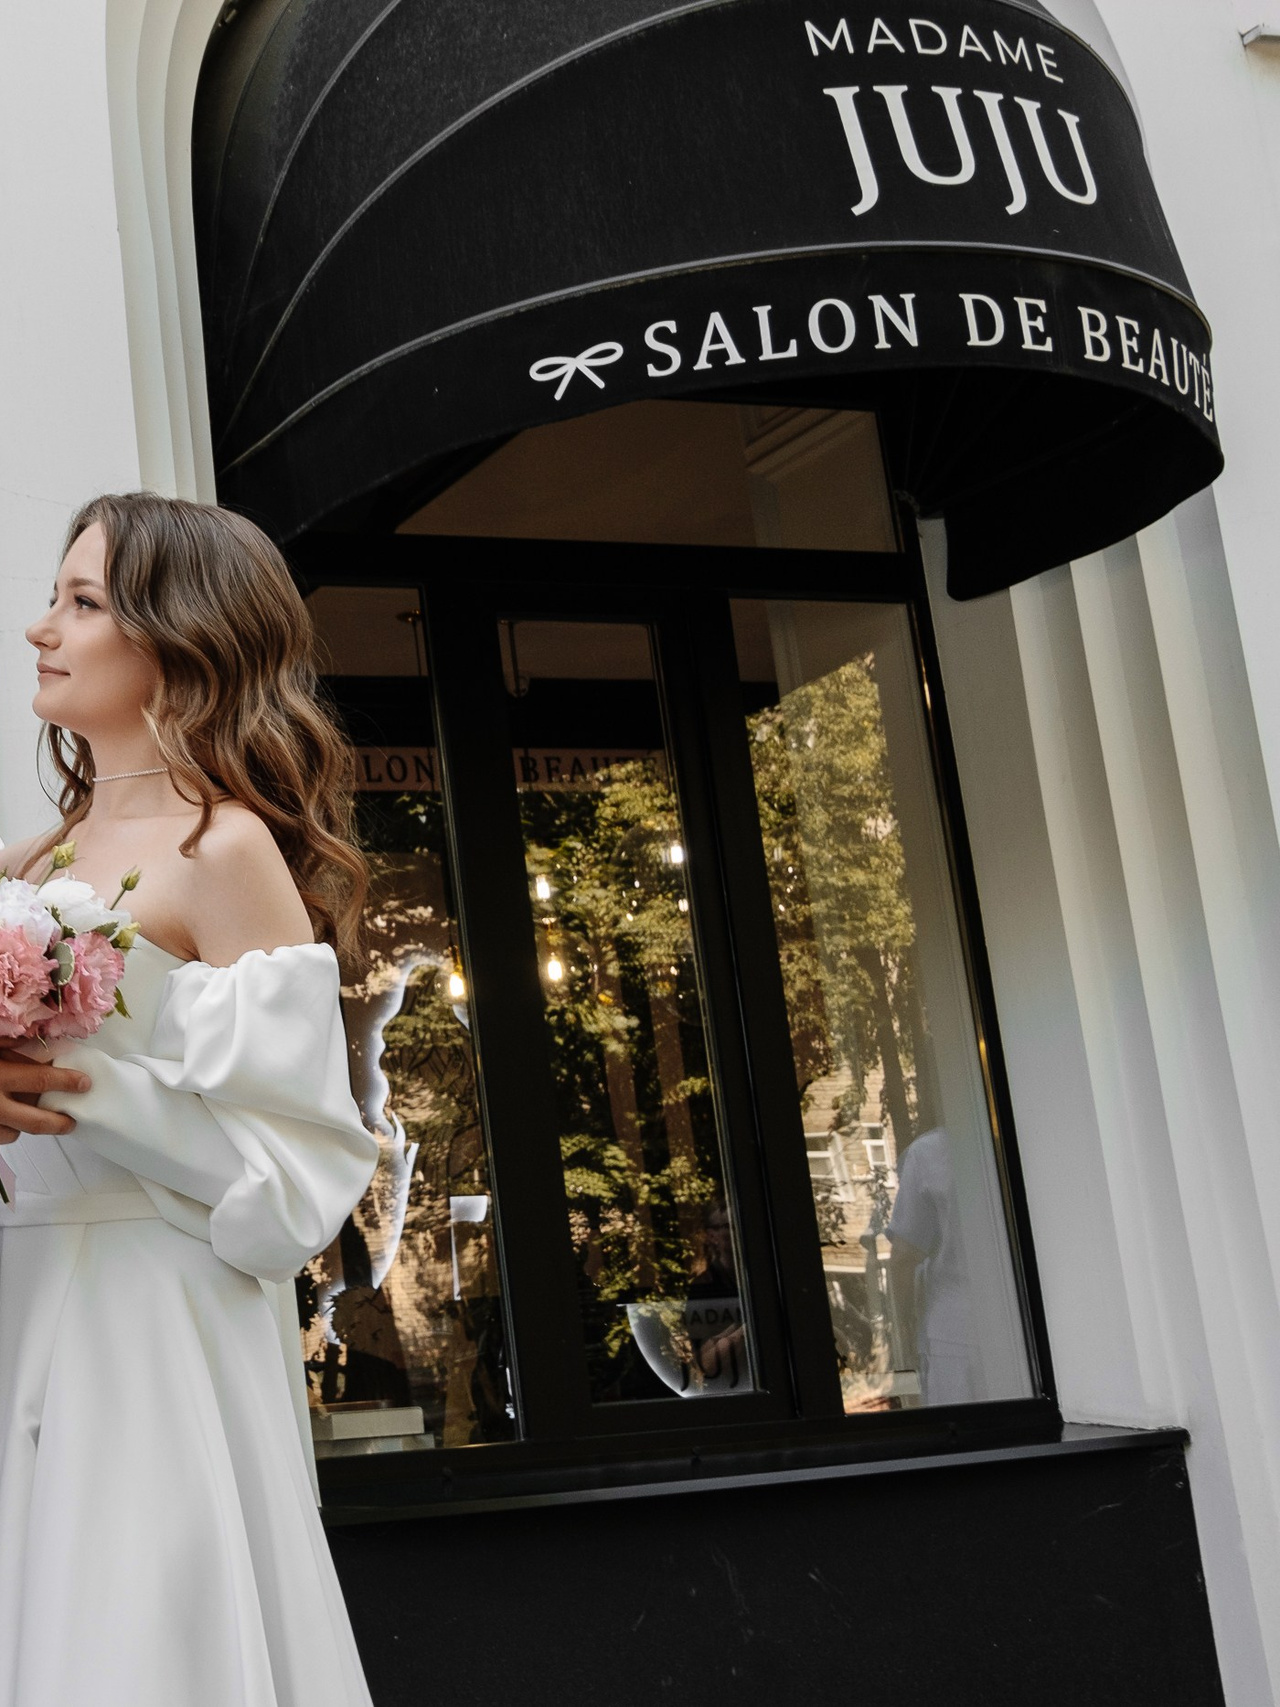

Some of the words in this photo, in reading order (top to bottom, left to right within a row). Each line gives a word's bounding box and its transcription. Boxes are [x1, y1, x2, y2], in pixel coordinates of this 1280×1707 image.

[805, 18, 1064, 84] MADAME
[823, 85, 1098, 216] JUJU
[644, 293, 919, 377] SALON
[959, 293, 1053, 352] DE
[1077, 306, 1213, 422] BEAUTÉ
[356, 754, 435, 783] LON
